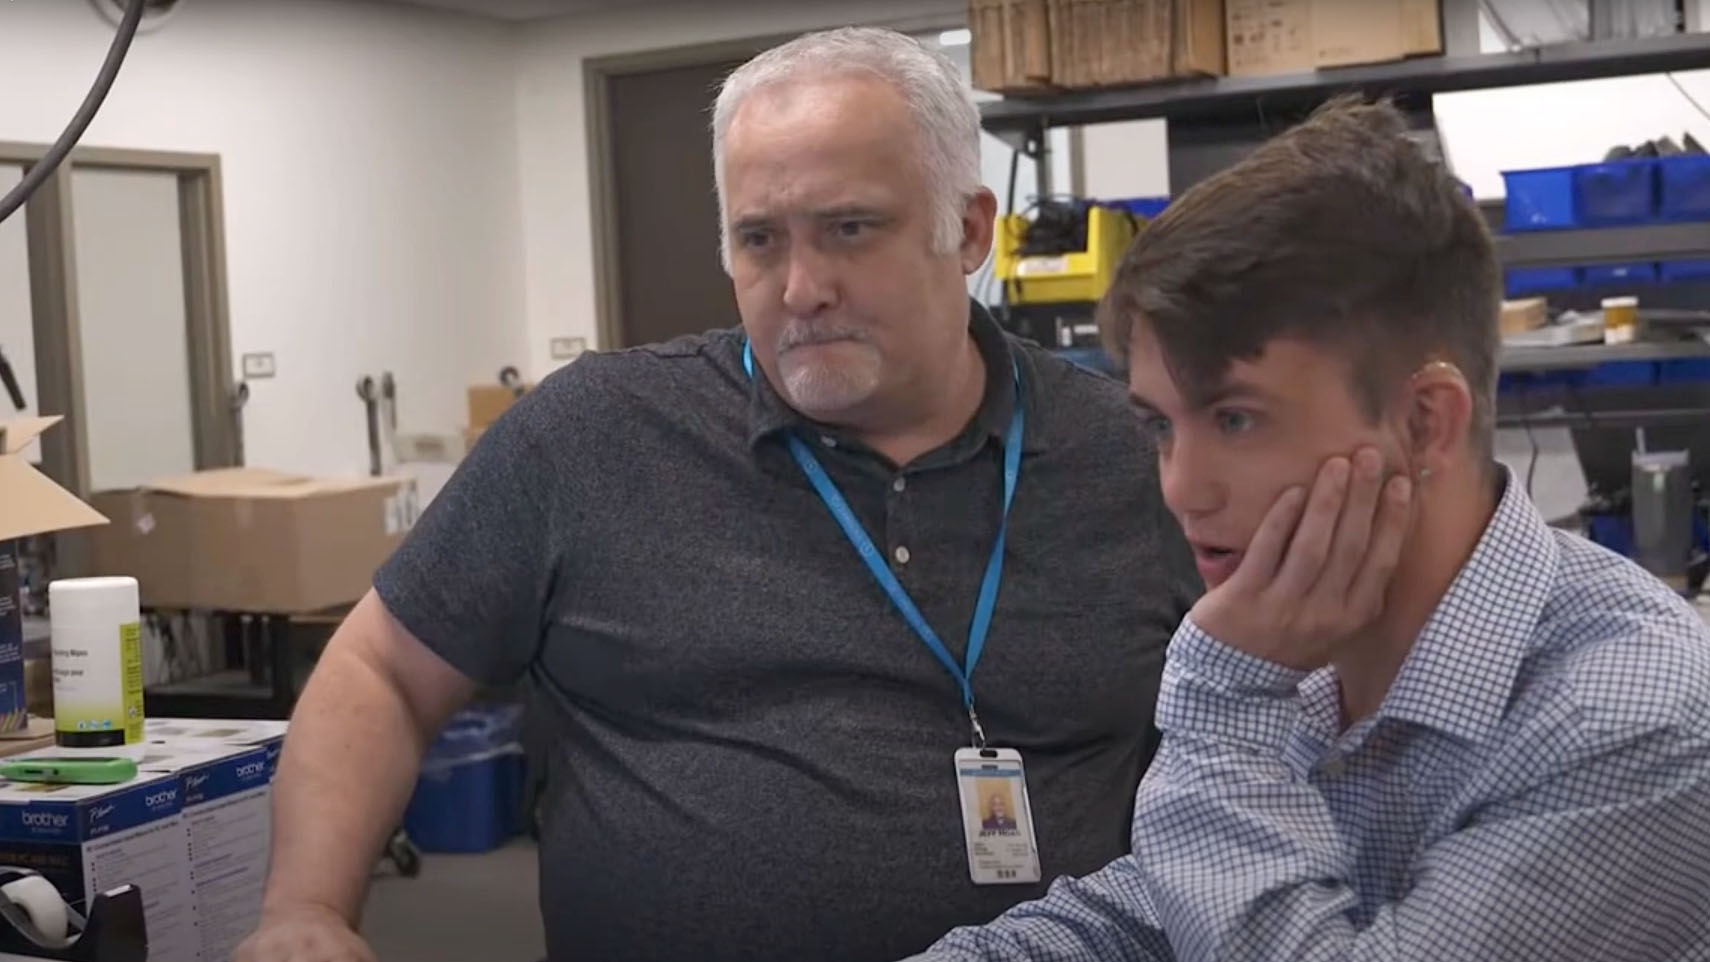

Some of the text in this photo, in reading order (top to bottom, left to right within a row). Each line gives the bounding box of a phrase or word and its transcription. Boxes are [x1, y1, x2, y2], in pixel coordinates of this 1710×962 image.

[235, 761, 265, 777] brother
[145, 788, 178, 806] brother
[21, 810, 69, 827] brother
